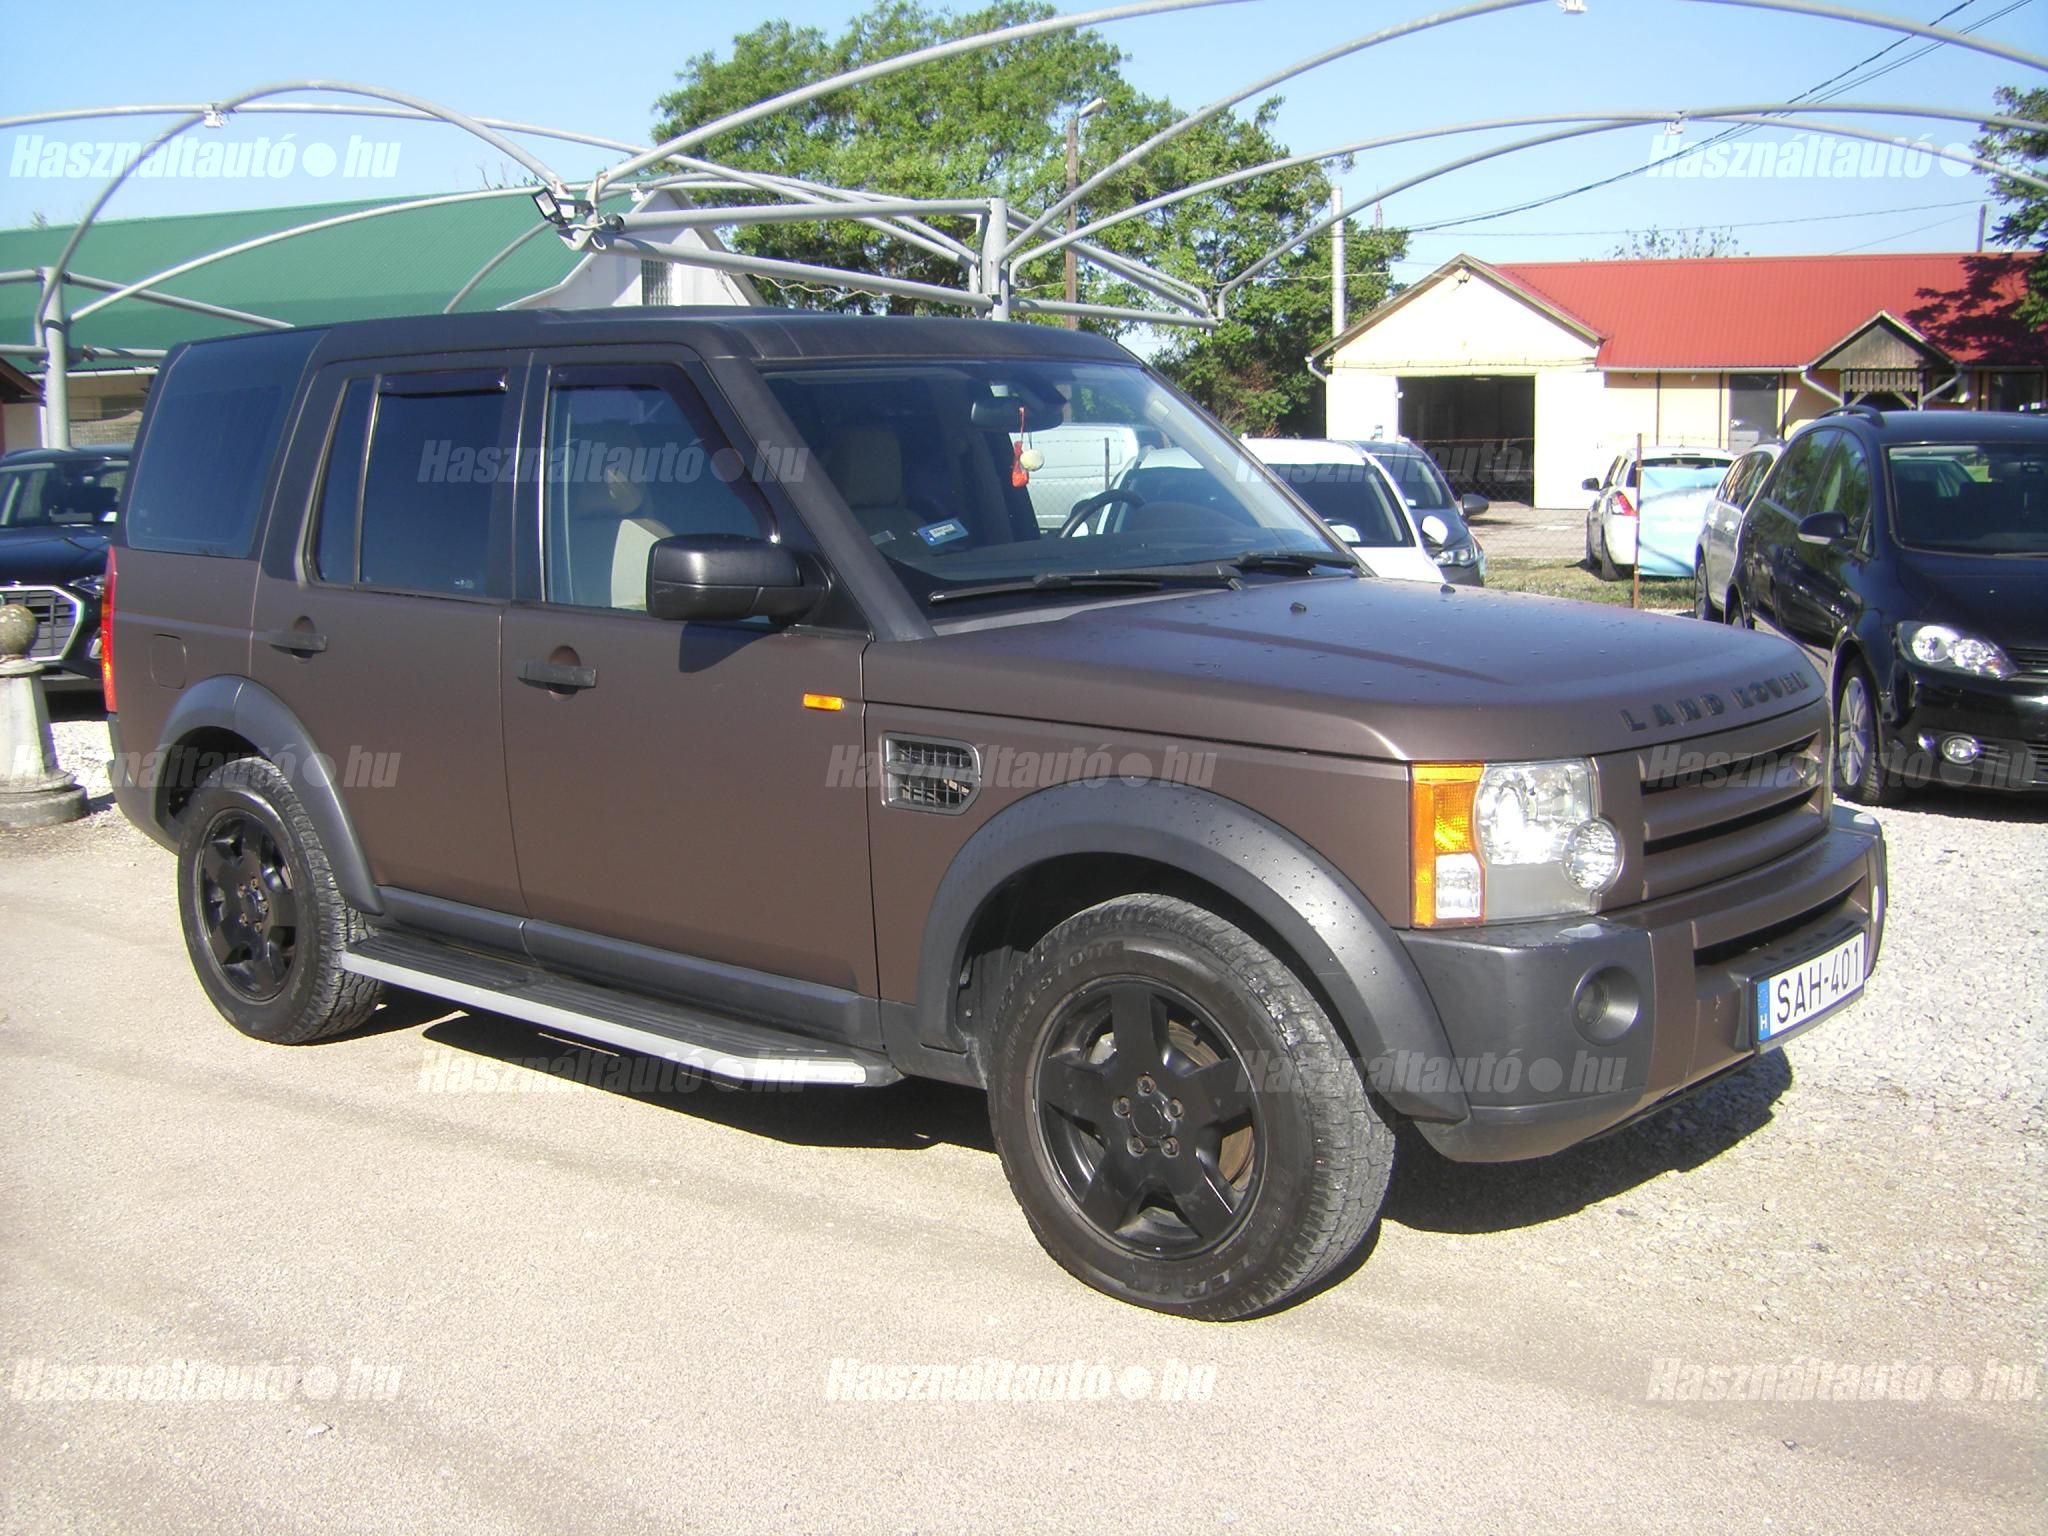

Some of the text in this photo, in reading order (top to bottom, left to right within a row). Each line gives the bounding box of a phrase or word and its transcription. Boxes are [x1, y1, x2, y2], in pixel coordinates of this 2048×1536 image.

[1620, 693, 1725, 732] LAND
[1760, 941, 1859, 1031] H SAH-401
